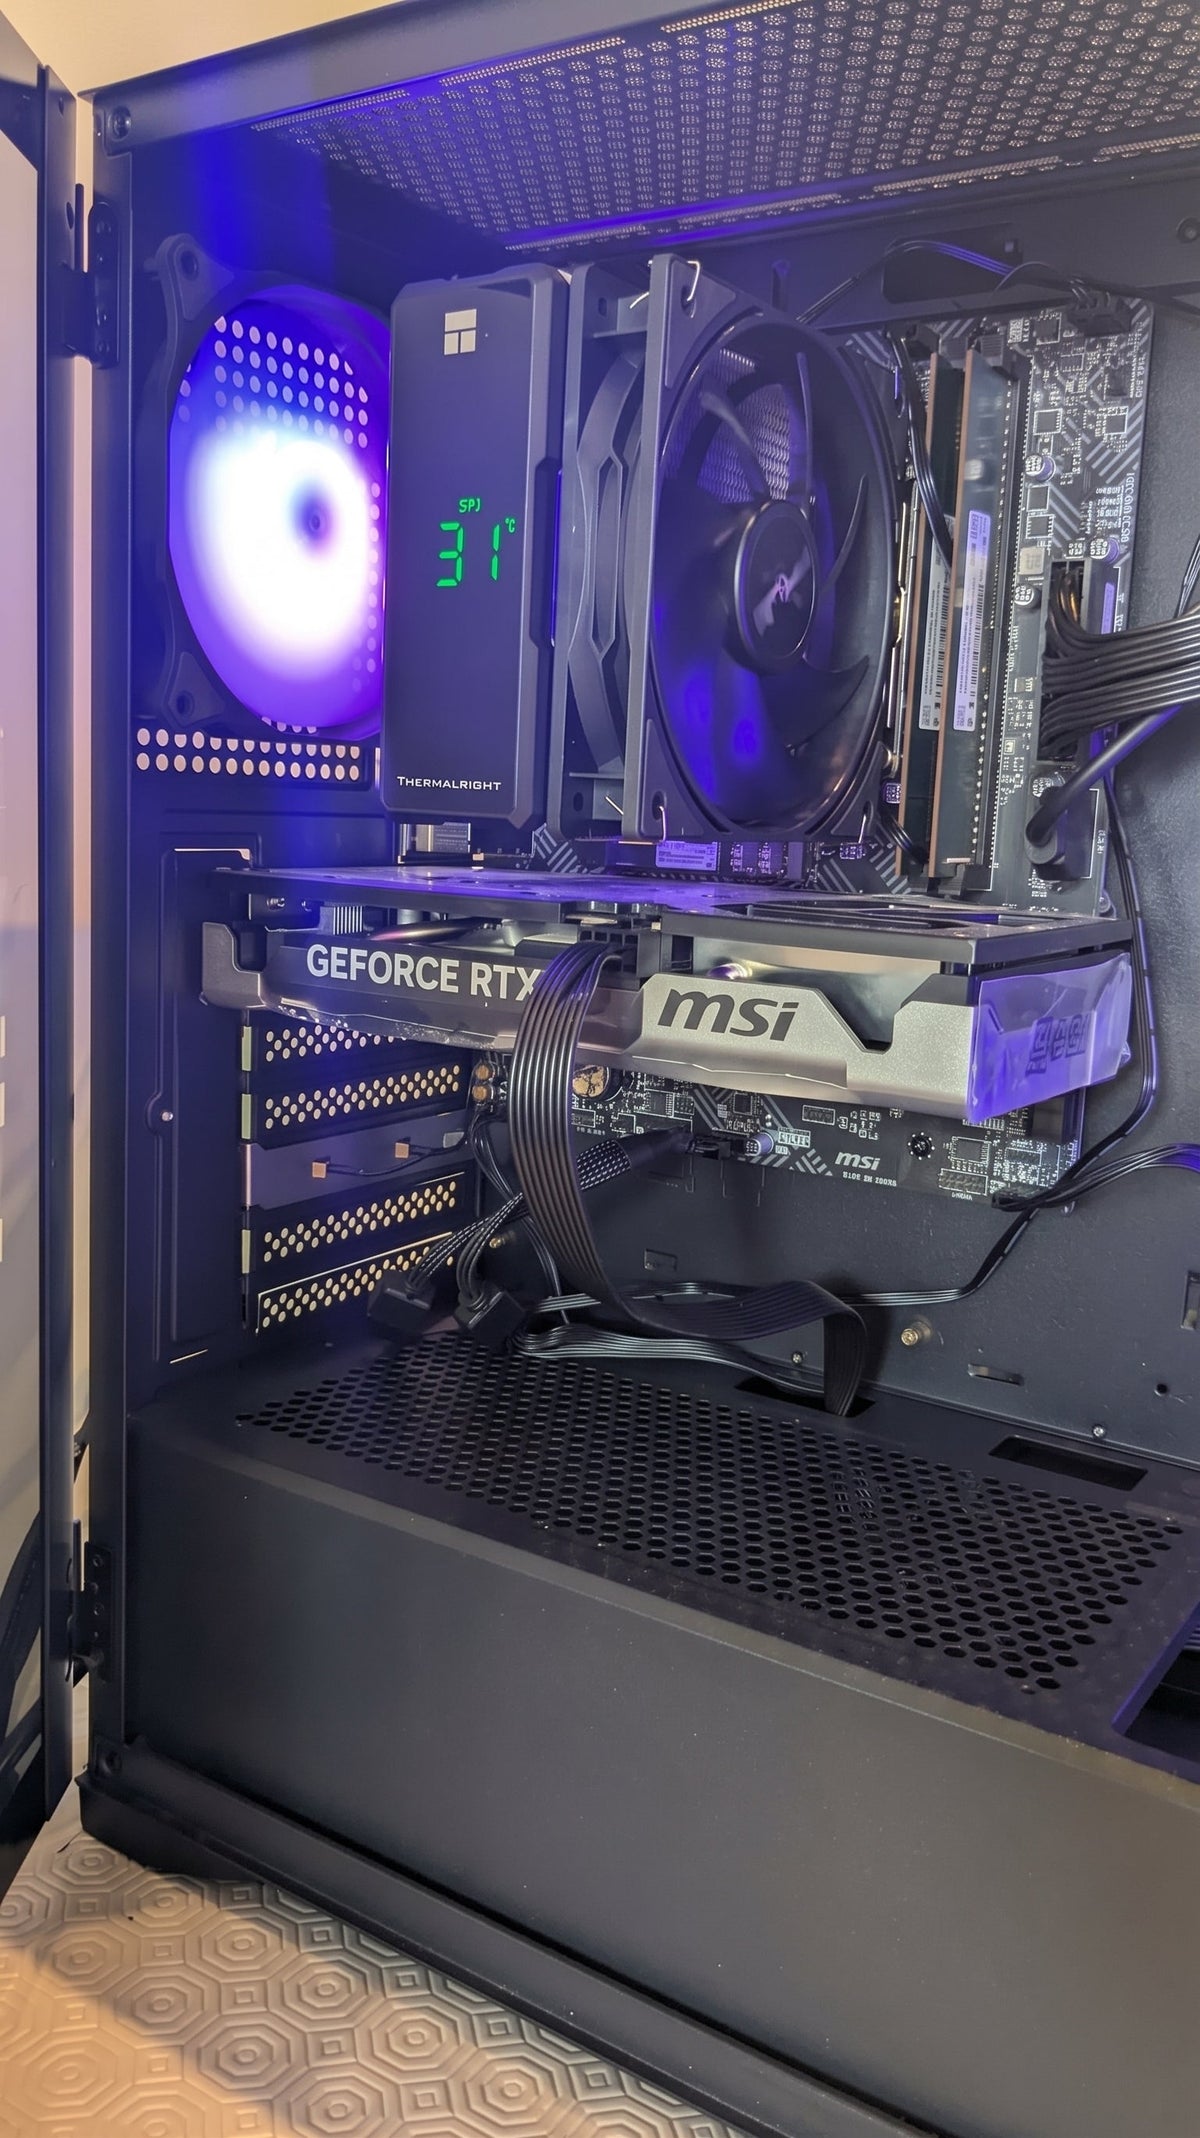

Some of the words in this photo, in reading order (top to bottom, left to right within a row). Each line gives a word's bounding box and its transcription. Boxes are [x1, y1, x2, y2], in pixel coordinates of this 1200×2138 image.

[397, 776, 502, 791] THERMALRIGHT
[306, 944, 460, 994] GEFORCE
[470, 961, 542, 1001] RTX
[657, 988, 800, 1042] msi
[834, 1151, 881, 1171] msi
